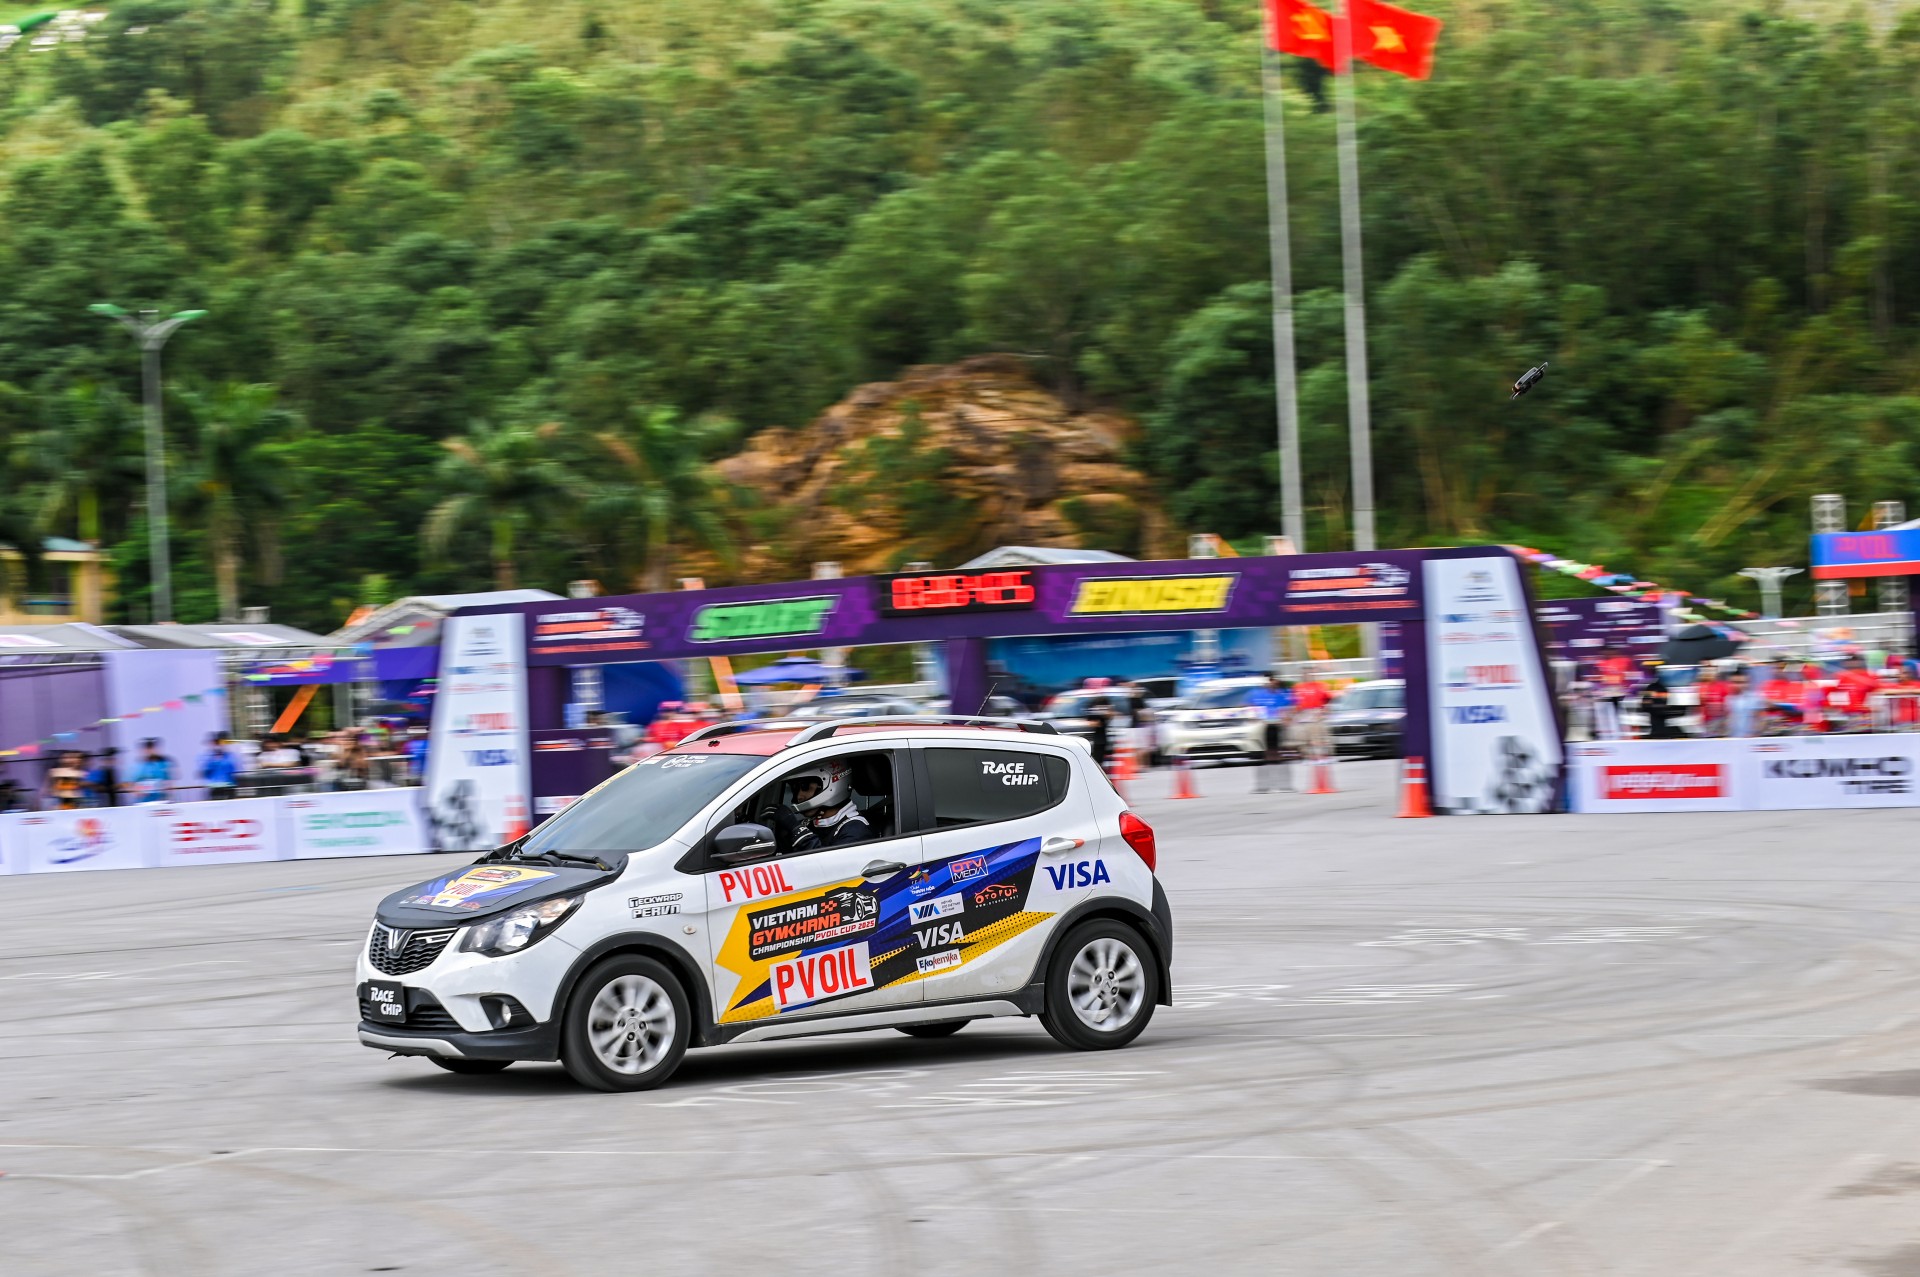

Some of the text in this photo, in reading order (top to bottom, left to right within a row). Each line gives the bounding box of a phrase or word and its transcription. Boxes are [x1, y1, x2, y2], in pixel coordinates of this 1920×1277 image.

[982, 761, 1025, 775] RACE
[1002, 774, 1039, 786] CHIP
[719, 863, 794, 903] PVOIL
[953, 867, 988, 880] MEDIA
[1042, 859, 1111, 891] VISA
[753, 903, 818, 930] VIETNAM
[753, 913, 841, 946] GYMKHANA
[753, 920, 875, 955] CHAMPIONSHIP PVOIL CUP 2025
[913, 921, 965, 950] VISA
[776, 948, 867, 1005] PVOIL
[371, 987, 394, 1002] RACE
[381, 1003, 402, 1016] CHIP
